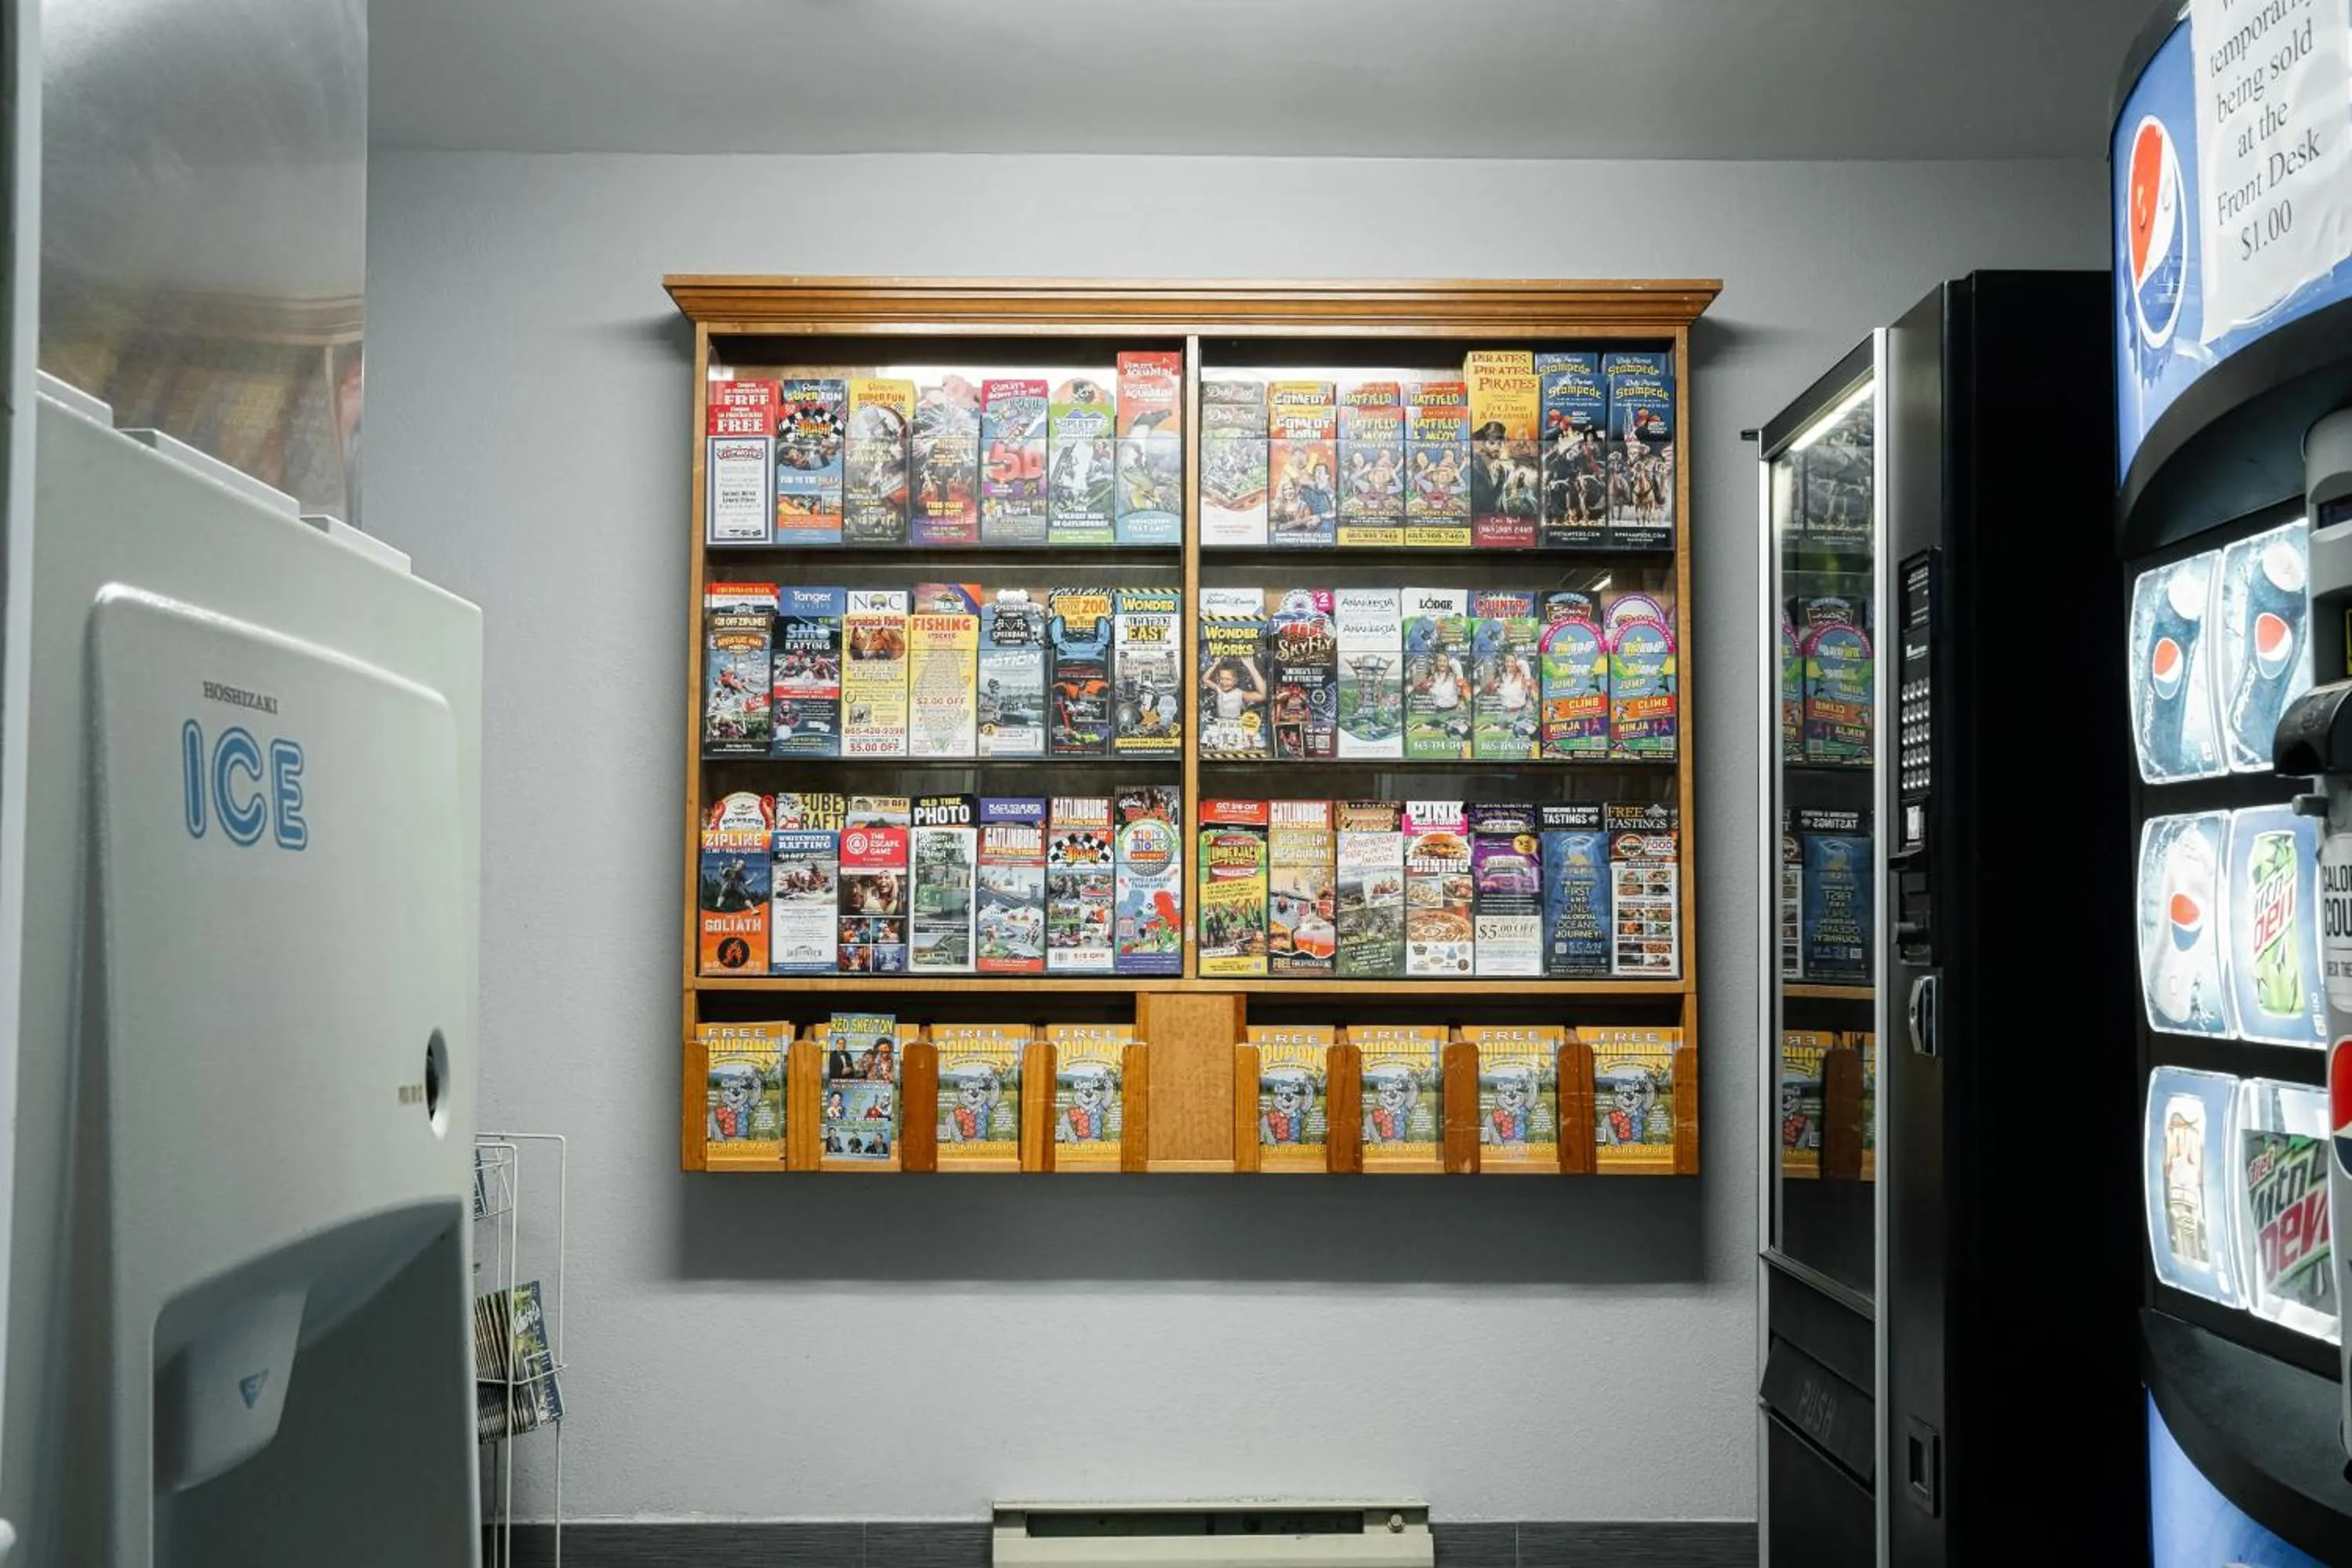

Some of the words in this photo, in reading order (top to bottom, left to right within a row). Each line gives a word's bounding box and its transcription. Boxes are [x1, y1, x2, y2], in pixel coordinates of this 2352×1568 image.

[2210, 0, 2314, 78] temporar
[2216, 76, 2264, 122] being
[2270, 17, 2313, 79] sold
[2238, 125, 2252, 158] at
[2259, 103, 2288, 140] the
[2217, 174, 2263, 227] Front
[2269, 128, 2321, 188] Desk
[2241, 199, 2292, 262] $1.00
[1474, 366, 1530, 375] PIRATES
[1479, 377, 1536, 391] PIRATES
[717, 418, 764, 432] FREE
[793, 591, 831, 604] Tanger
[1122, 597, 1176, 612] WONDER
[1418, 598, 1453, 610] LODGE
[912, 617, 971, 631] FISHING
[1127, 626, 1169, 641] EAST
[1204, 625, 1258, 640] WONDER
[785, 641, 830, 650] RAFTING
[1208, 643, 1254, 656] WORKS
[981, 653, 1040, 666] MOTION
[203, 681, 278, 714] HOSHIZAKI
[1569, 698, 1599, 709] CLIMB
[1638, 698, 1668, 710] CLIMB
[1550, 720, 1581, 733] NINJA
[1618, 720, 1649, 733] NINJA
[880, 743, 900, 752] OFF
[183, 718, 308, 851] ICE
[942, 797, 962, 806] TIME
[914, 805, 971, 825] PHOTO
[1411, 803, 1463, 818] PINK
[1608, 807, 1644, 818] FREE
[1543, 814, 1588, 824] TASTINGS
[1607, 818, 1667, 829] TASTINGS
[705, 833, 763, 847] ZIPLINE
[1412, 858, 1468, 873] DINING
[705, 918, 761, 932] GOLIATH
[709, 1028, 766, 1037] FREE
[831, 1018, 849, 1033] RED
[1480, 1031, 1539, 1040] FREE
